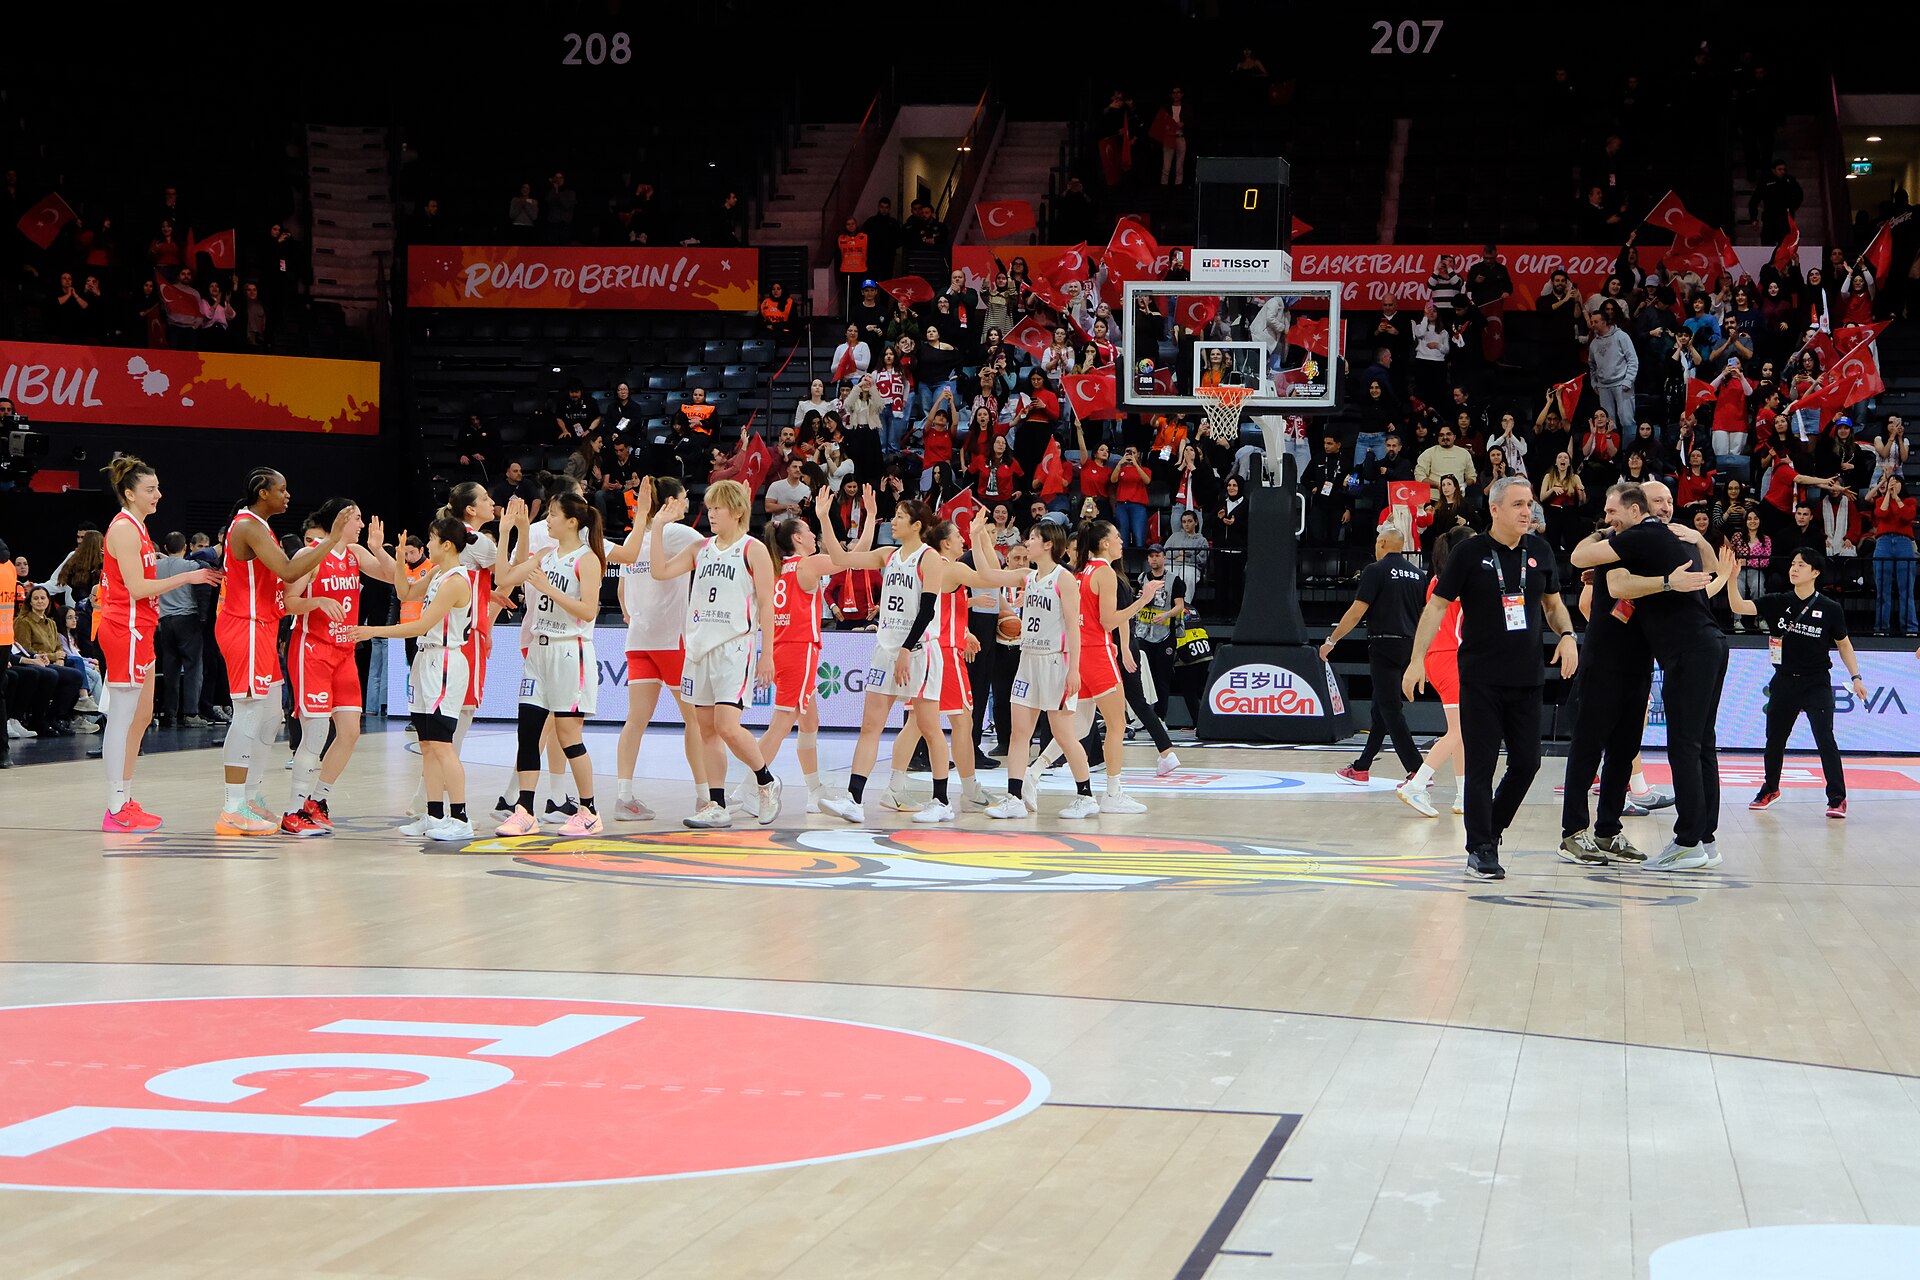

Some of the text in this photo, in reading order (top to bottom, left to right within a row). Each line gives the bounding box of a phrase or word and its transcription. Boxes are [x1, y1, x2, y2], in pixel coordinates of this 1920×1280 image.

[1370, 20, 1444, 54] 207
[562, 32, 632, 65] 208
[1244, 189, 1258, 210] 0
[1222, 259, 1270, 269] TISSOT
[1300, 254, 1425, 275] BASKETBALL
[1515, 254, 1562, 275] CUP
[1568, 256, 1617, 275] 2026
[464, 256, 700, 299] ROAD TO BERLIN!!
[544, 570, 569, 593] APAN
[699, 563, 735, 581] JAPAN
[342, 596, 352, 613] 6
[538, 594, 554, 613] 31
[708, 587, 717, 603] 8
[887, 595, 904, 613] 52
[1027, 617, 1041, 633] 26
[1229, 671, 1293, 689] 百岁山
[1831, 685, 1908, 715] BVA
